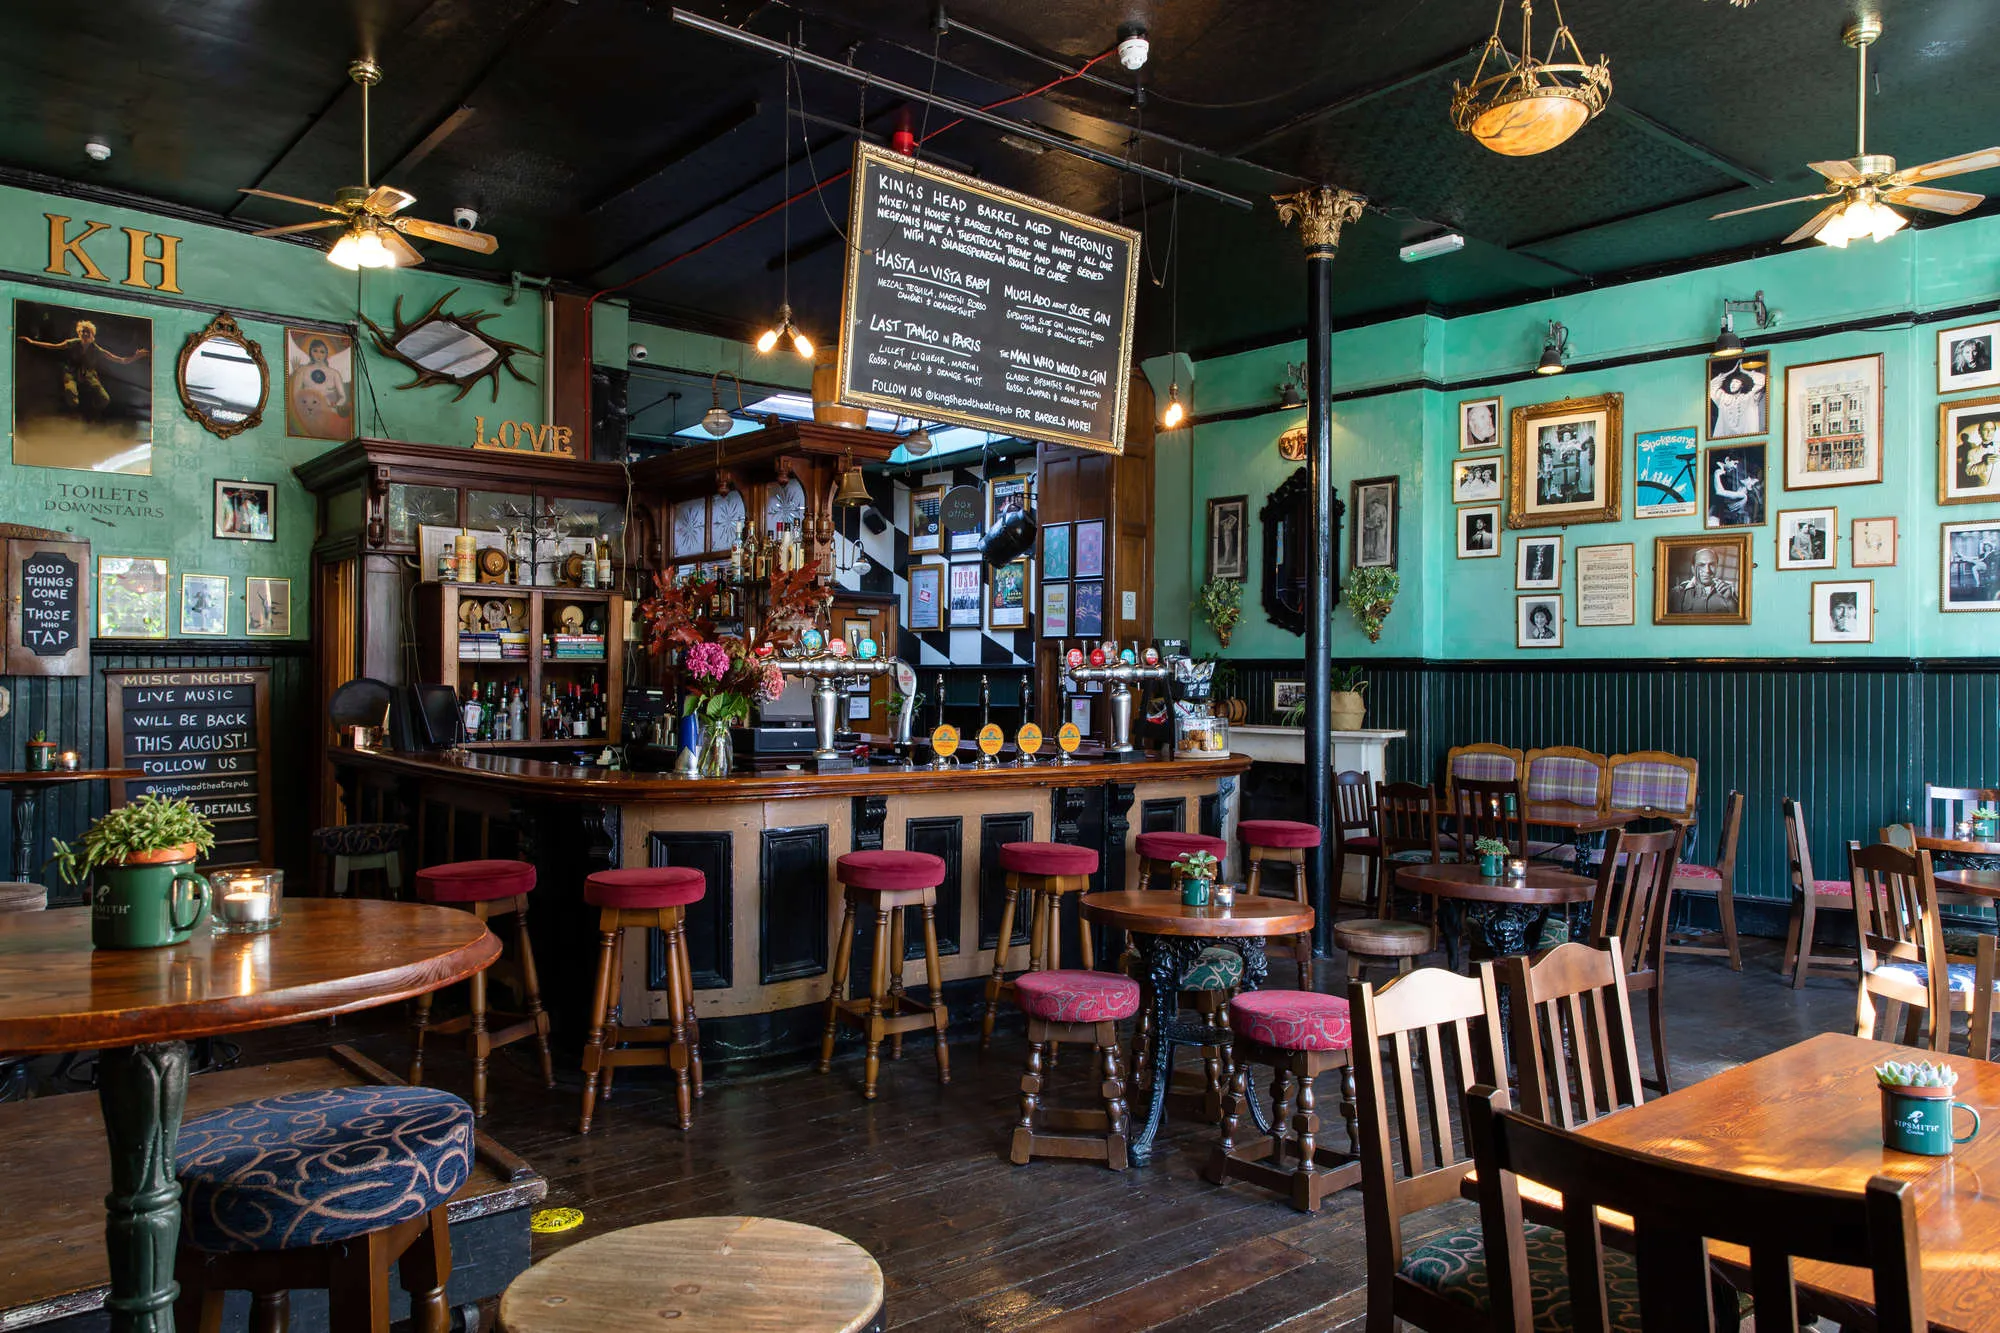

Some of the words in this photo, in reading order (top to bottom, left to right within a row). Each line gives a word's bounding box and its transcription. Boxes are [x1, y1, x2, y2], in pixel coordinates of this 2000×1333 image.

[879, 194, 908, 210] MIXED
[912, 204, 920, 214] IN
[924, 207, 952, 222] HOUSE
[954, 215, 960, 226] &
[964, 218, 992, 234] BARREL
[994, 227, 1014, 240] AGED
[1016, 234, 1030, 246] FOR
[1034, 240, 1048, 251] ONE
[1084, 256, 1096, 266] ALL
[1100, 260, 1114, 272] OUR
[934, 190, 966, 212] HEAD
[978, 204, 1019, 226] BARREL
[1025, 220, 1052, 234] AGED
[1060, 231, 1113, 260] NEGRONIS
[878, 208, 920, 228] NEGRONIS
[924, 220, 944, 234] HAVE
[946, 226, 954, 237] A
[957, 230, 1002, 251] THEATRICAL
[1006, 244, 1032, 260] THEME
[1034, 254, 1050, 265] AND
[1056, 260, 1072, 273] ARE
[1077, 266, 1104, 280] SERVED
[903, 227, 924, 242] WITH
[929, 235, 936, 246] A
[941, 238, 1006, 265] SHAKESPEAREAN
[1007, 257, 1030, 272] SKULL
[1034, 264, 1046, 276] ICE
[875, 248, 916, 274] HASTA
[920, 264, 928, 273] LA
[930, 265, 962, 286] VISTA
[965, 274, 990, 294] BABY
[878, 278, 904, 290] MEZCAL
[938, 292, 964, 304] MARTINI
[966, 298, 987, 311] ROSSO
[897, 291, 923, 304] CAMPARI
[933, 301, 958, 313] ORANGE
[1004, 284, 1032, 304] MUCH
[1032, 293, 1051, 308] ADO
[1052, 302, 1068, 310] ABOUT
[1068, 302, 1091, 319] SLOE
[1094, 311, 1112, 326] GIN
[869, 314, 902, 332] LAST
[904, 323, 939, 344] TANGO
[942, 335, 950, 344] IN
[952, 332, 982, 352] PARIS
[1020, 322, 1044, 334] CAMPARI
[1054, 332, 1076, 344] ORANGE
[1038, 317, 1052, 328] SLOE
[1068, 326, 1090, 336] MARTINI
[1090, 331, 1105, 342] ROSSO
[879, 344, 906, 356] LILLET
[951, 360, 979, 372] MARTINI
[1000, 350, 1010, 359] THE
[1010, 348, 1030, 364] MAN
[1032, 354, 1054, 370] WHO
[1056, 361, 1080, 378] WOULD
[1090, 370, 1107, 386] GIN
[894, 360, 922, 372] CAMPARI
[936, 368, 962, 381] ORANGE
[1005, 372, 1030, 382] CLASSIC
[1080, 388, 1102, 400] MARTINI
[872, 379, 906, 396] FOLLOW
[910, 386, 922, 398] US
[925, 390, 1012, 416] @kingsheadtheatrepub
[1015, 406, 1031, 420] FOR
[1034, 411, 1066, 427] BARRELS
[1067, 418, 1092, 433] MORE!
[1026, 386, 1051, 400] CAMPARI
[1060, 396, 1080, 406] ORANGE
[1081, 400, 1098, 412] TWIST
[474, 415, 574, 456] LOVE
[1638, 436, 1696, 452] Spokesong
[57, 483, 149, 502] TOILETS
[44, 500, 164, 518] DOWNSTAIRS
[954, 500, 972, 509] box
[948, 510, 976, 520] office
[28, 564, 64, 574] GOOD
[25, 576, 74, 588] THINGS
[954, 571, 978, 588] TOSCA
[32, 588, 68, 600] COME
[25, 608, 71, 620] THOSE
[28, 630, 70, 645] TAP
[124, 674, 181, 686] MUSIC
[191, 673, 256, 684] NIGHTS
[138, 691, 174, 702] LIVE
[185, 690, 233, 702] MUSIC
[134, 715, 173, 726] WILL
[180, 714, 198, 726] BE
[206, 714, 248, 727] BACK
[135, 736, 172, 752] THIS
[178, 732, 248, 750] AUGUST!
[144, 758, 206, 773] FOLLOW
[218, 757, 238, 770] US
[146, 780, 248, 796] @kingsheadtheatrepub
[204, 803, 251, 814] DETAILS
